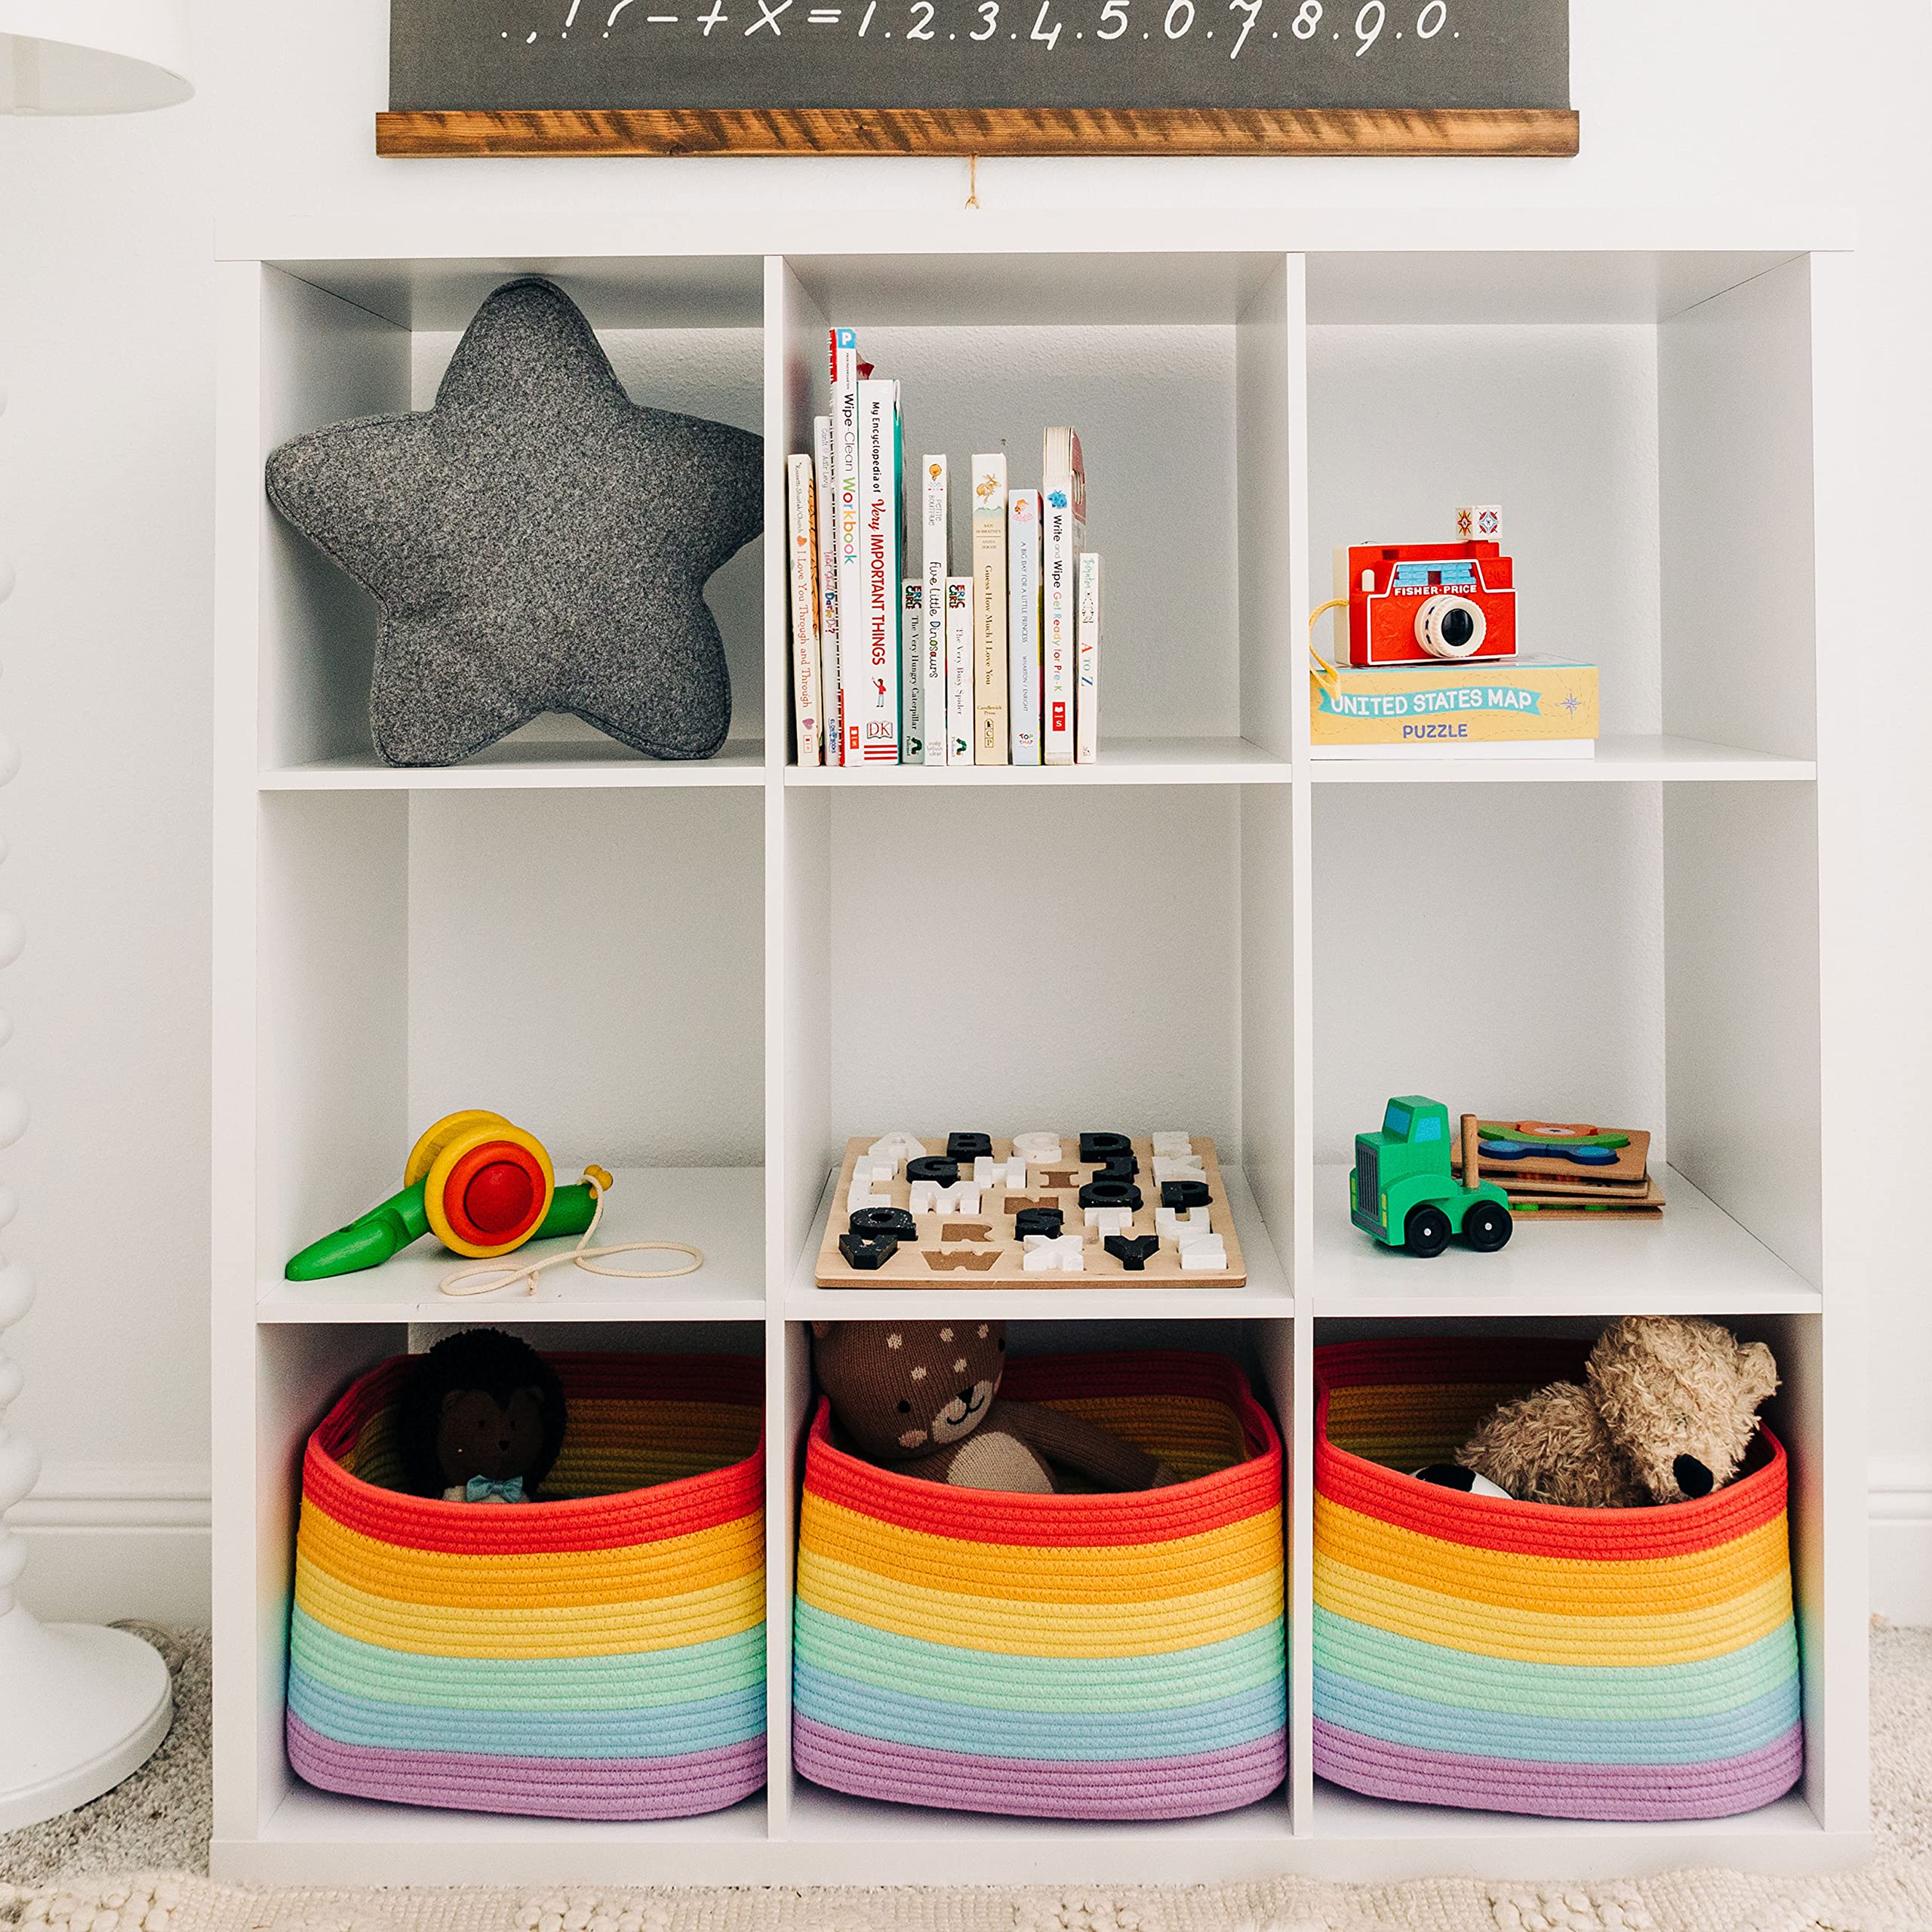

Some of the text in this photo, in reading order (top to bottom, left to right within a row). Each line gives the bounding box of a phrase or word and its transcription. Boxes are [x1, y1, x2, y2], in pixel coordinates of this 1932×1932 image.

[842, 332, 851, 346] P
[842, 393, 857, 565] Wipe-Clean Workbook
[868, 401, 886, 666] My Encyclopedia of Very IMPORTANT THINGS
[1054, 515, 1063, 542] Write
[797, 558, 806, 580] Love
[984, 565, 992, 590] Guess
[1052, 560, 1063, 589] Wipe
[1081, 558, 1095, 589] Boynton
[798, 583, 808, 602] You
[905, 585, 913, 610] CARLE
[913, 586, 922, 609] ERIC
[949, 584, 957, 609] CARLE
[956, 584, 965, 608] ERIC
[1054, 592, 1062, 610] Get
[798, 605, 809, 645] Through
[929, 561, 942, 678] Five Little Dinosaurs
[1052, 614, 1062, 646] Ready
[909, 634, 919, 652] Very
[954, 646, 964, 663] Very
[1054, 649, 1062, 663] for
[800, 648, 810, 665] and
[1081, 643, 1093, 687] A TO Z
[909, 655, 919, 685] Hungry
[954, 667, 964, 686] Busy
[1054, 666, 1063, 691] Pre-K
[800, 668, 812, 708] Through
[909, 688, 919, 731] Caterpillar
[954, 690, 964, 715] Spider
[1331, 688, 1532, 715] UNITED STATES MAP
[869, 722, 891, 736] DK
[1403, 723, 1468, 739] PUZZLE
[946, 1132, 992, 1163] B
[1079, 1132, 1133, 1163] D
[906, 1155, 961, 1187] G
[974, 1156, 1027, 1188] H
[847, 1180, 891, 1214] L
[909, 1180, 982, 1214] M
[1078, 1180, 1144, 1212] O
[1160, 1180, 1214, 1214] P
[1014, 1208, 1064, 1241] S
[1084, 1208, 1133, 1236] T
[1155, 1208, 1213, 1240] U
[838, 1234, 900, 1270] V
[920, 1251, 1004, 1271] W
[1023, 1235, 1084, 1272] X
[1103, 1235, 1160, 1271] Y
